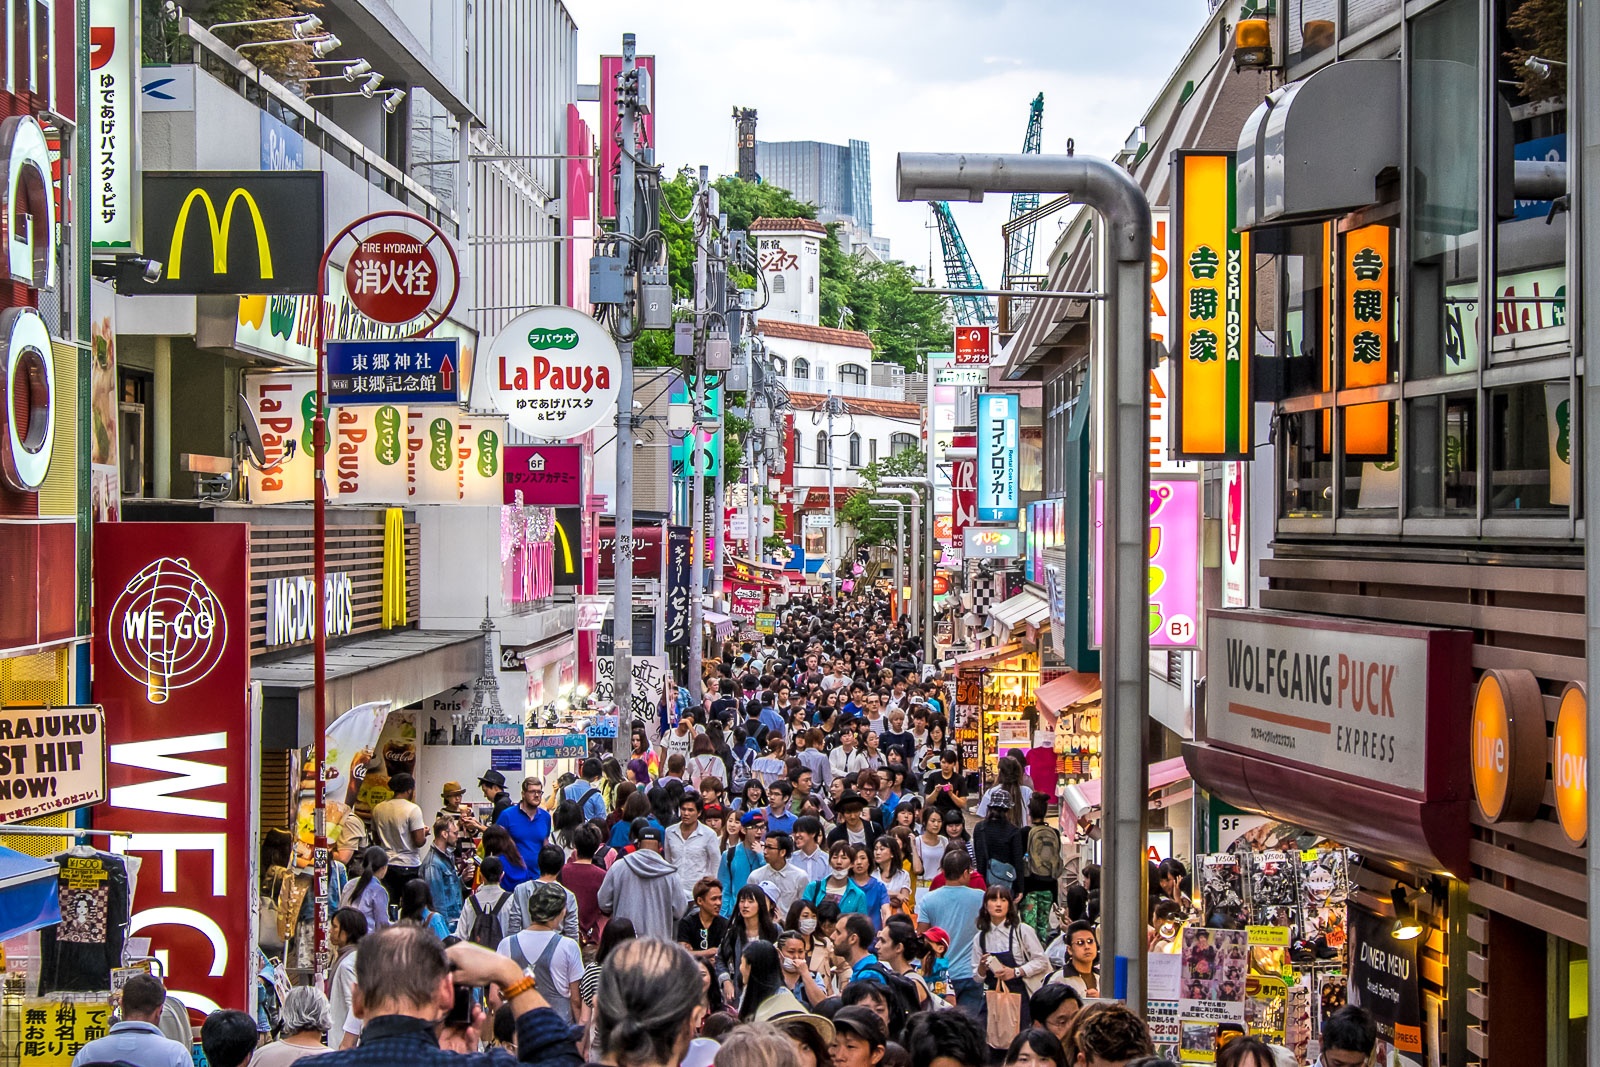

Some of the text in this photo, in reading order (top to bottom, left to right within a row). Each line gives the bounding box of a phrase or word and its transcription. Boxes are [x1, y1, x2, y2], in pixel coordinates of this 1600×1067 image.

[361, 242, 424, 254] FIRE HYDRANT
[759, 247, 799, 272] ジュネス
[354, 259, 432, 296] 消火栓
[1188, 245, 1219, 364] 吉野家
[351, 352, 432, 371] 東郷神社
[963, 354, 989, 363] アガサ
[351, 374, 437, 393] 東郷記念館
[499, 356, 610, 394] La Pausa
[516, 398, 594, 410] ゆであげパスタ
[537, 410, 567, 421] &ピザ
[337, 429, 368, 494] Pausa
[530, 459, 543, 468] 6F
[991, 419, 1005, 506] コインロッカー
[992, 508, 1004, 520] 1F
[985, 546, 998, 554] B1
[273, 572, 353, 646] McDoald's
[669, 586, 687, 643] ハセガワ
[1171, 622, 1190, 636] B1
[1226, 638, 1395, 719] WOLFGANG PUCK
[433, 700, 461, 711] Paris
[1336, 725, 1395, 764] EXPRESS
[1477, 720, 1505, 773] live
[35, 740, 83, 774] HIT
[1221, 818, 1240, 830] 3F
[69, 859, 99, 870] ¥1500
[1360, 941, 1410, 981] DINER MENU
[1262, 985, 1286, 997] 専門店
[25, 1008, 106, 1025] 無料で
[24, 1026, 106, 1041] お名前
